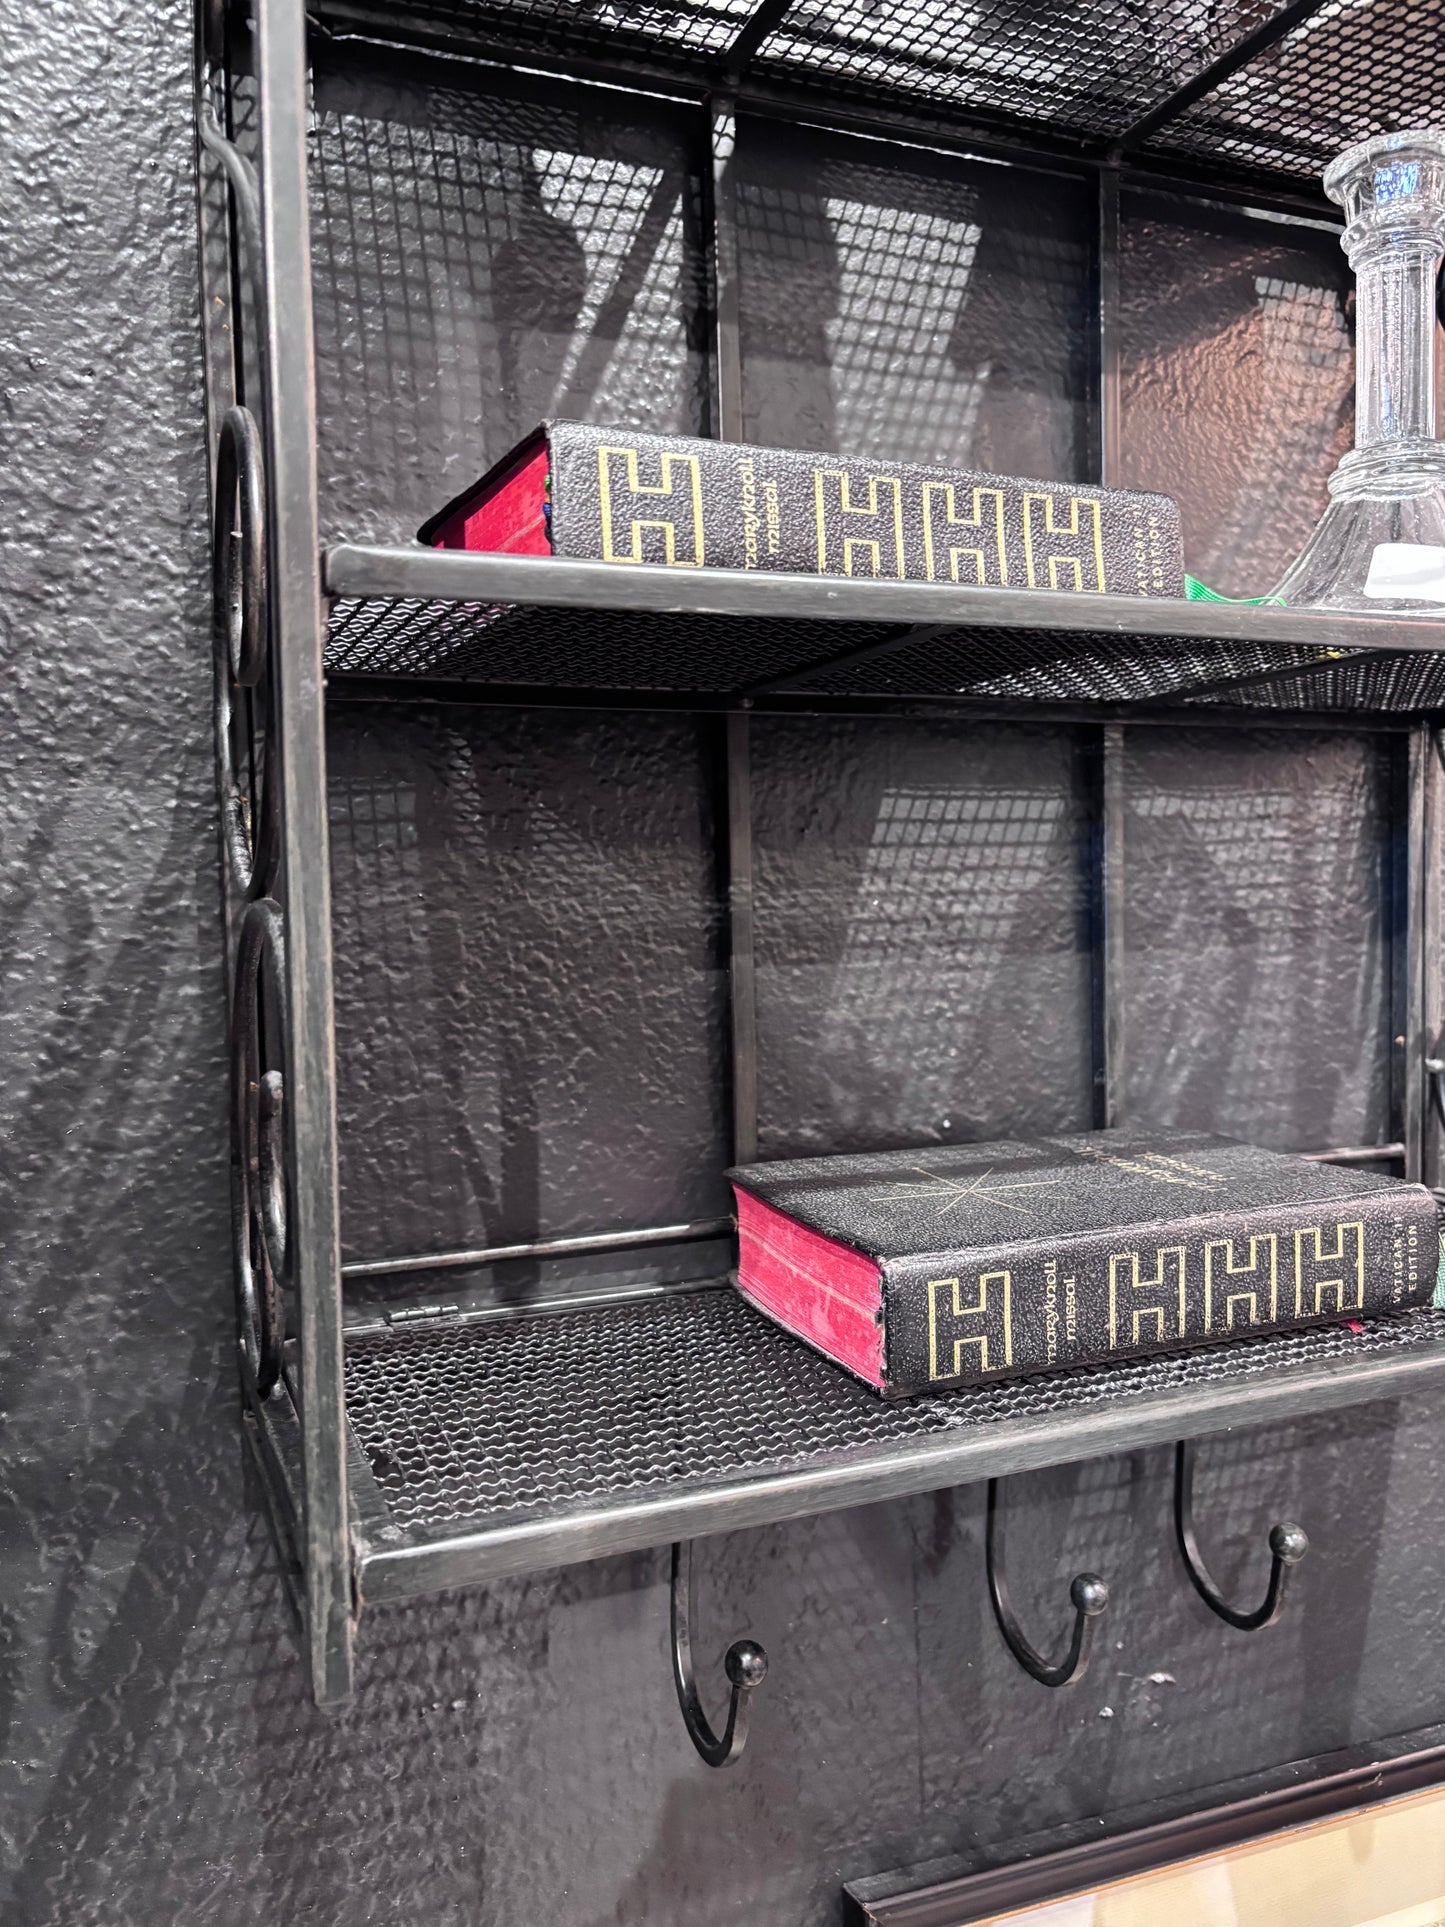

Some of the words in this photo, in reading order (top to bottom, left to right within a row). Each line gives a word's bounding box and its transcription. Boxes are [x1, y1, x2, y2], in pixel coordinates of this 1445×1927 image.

[762, 480, 780, 554] missal
[1148, 516, 1163, 588] EDITION
[1132, 526, 1148, 597] VATICAN
[1392, 1239, 1403, 1304] VATICAN
[1408, 1225, 1418, 1292] EDITION
[1043, 1259, 1060, 1366] maryknoll
[1063, 1275, 1077, 1340] missal
